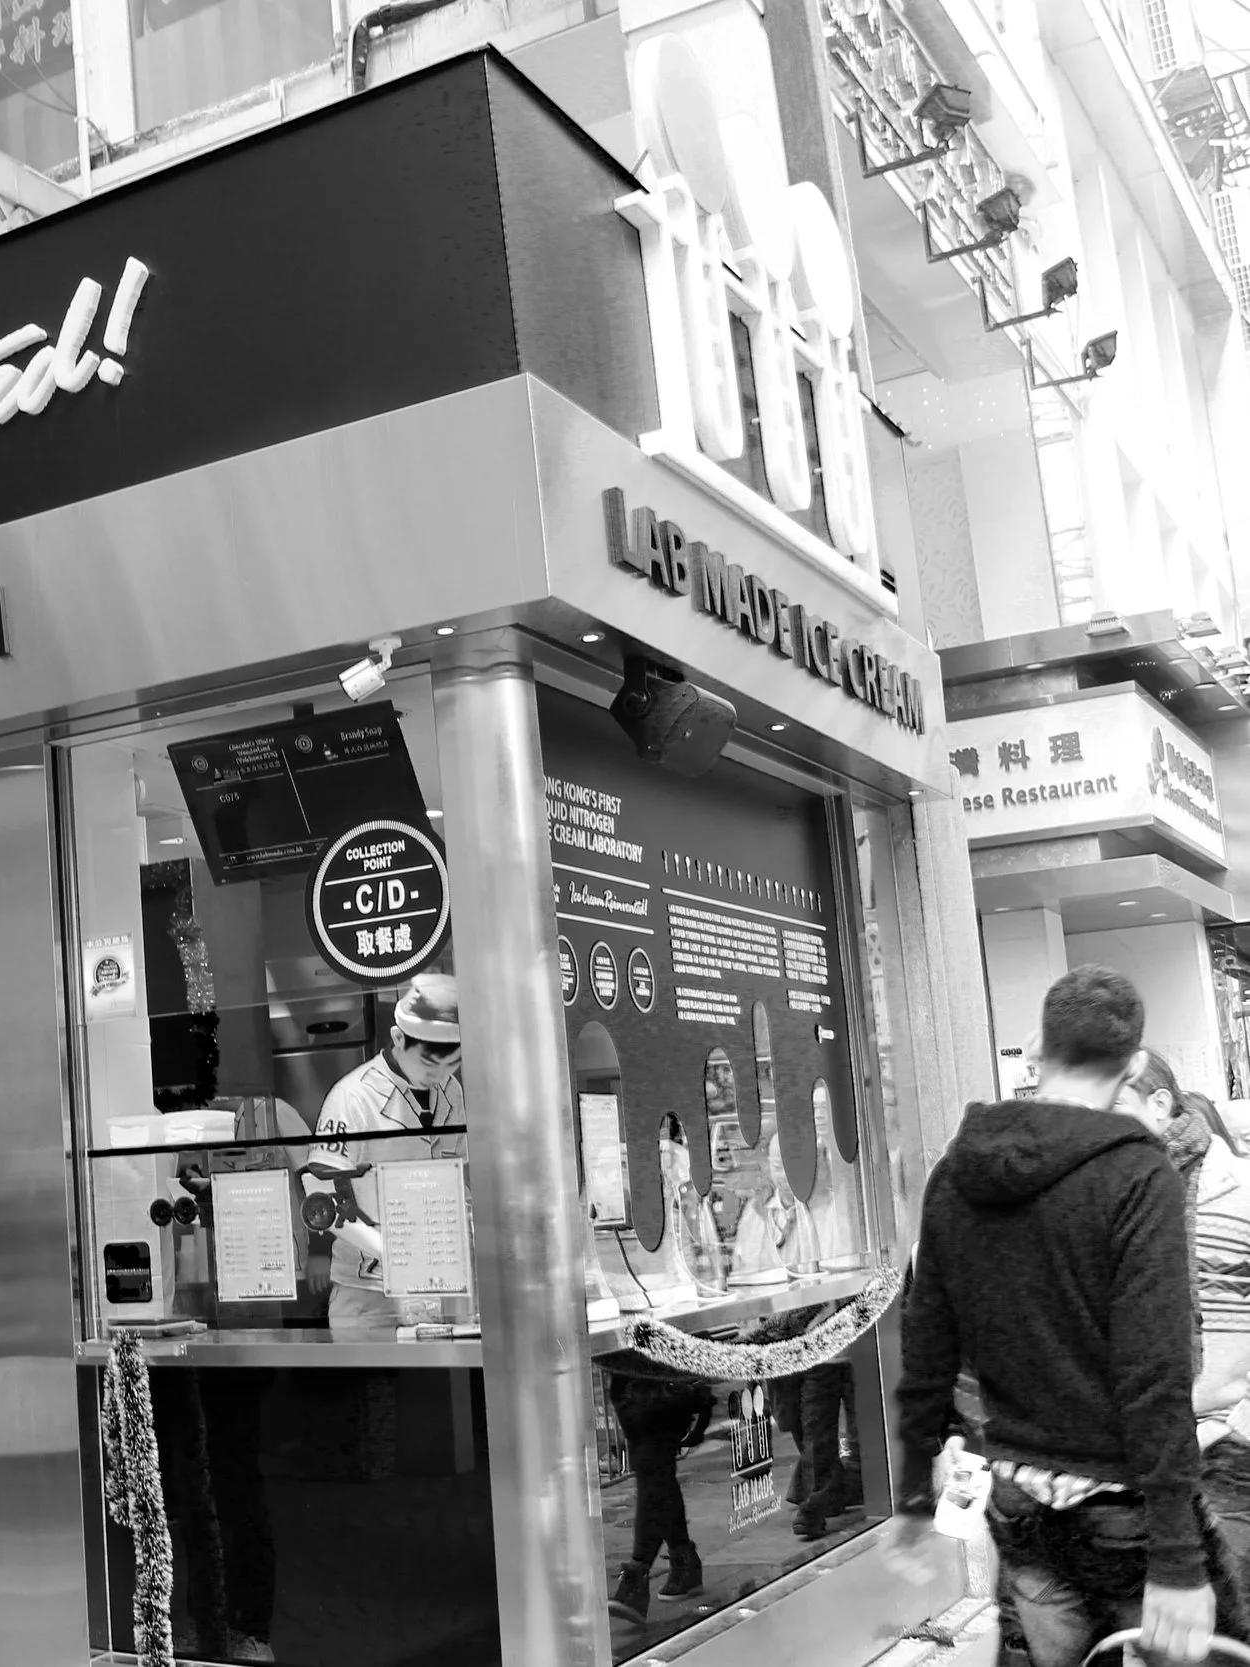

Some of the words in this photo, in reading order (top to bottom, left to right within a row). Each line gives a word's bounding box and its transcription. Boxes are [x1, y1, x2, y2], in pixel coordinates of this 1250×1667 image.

[601, 487, 689, 596] LAB
[688, 541, 793, 659] MADE
[790, 605, 842, 687] ICE
[841, 638, 925, 736] CREAM
[340, 728, 364, 742] Brandy
[365, 726, 383, 738] Snap
[563, 781, 597, 809] KONG'S
[598, 792, 622, 816] FIRST
[1001, 773, 1118, 808] Restaurant
[569, 804, 615, 835] NITROGEN
[346, 840, 405, 861] COLLECTION
[553, 823, 586, 849] CREAM
[587, 832, 643, 863] LABORATORY
[363, 856, 392, 872] POINT
[356, 923, 412, 957] 取餐處
[732, 1481, 749, 1511] LAB
[750, 1471, 775, 1504] MADE
